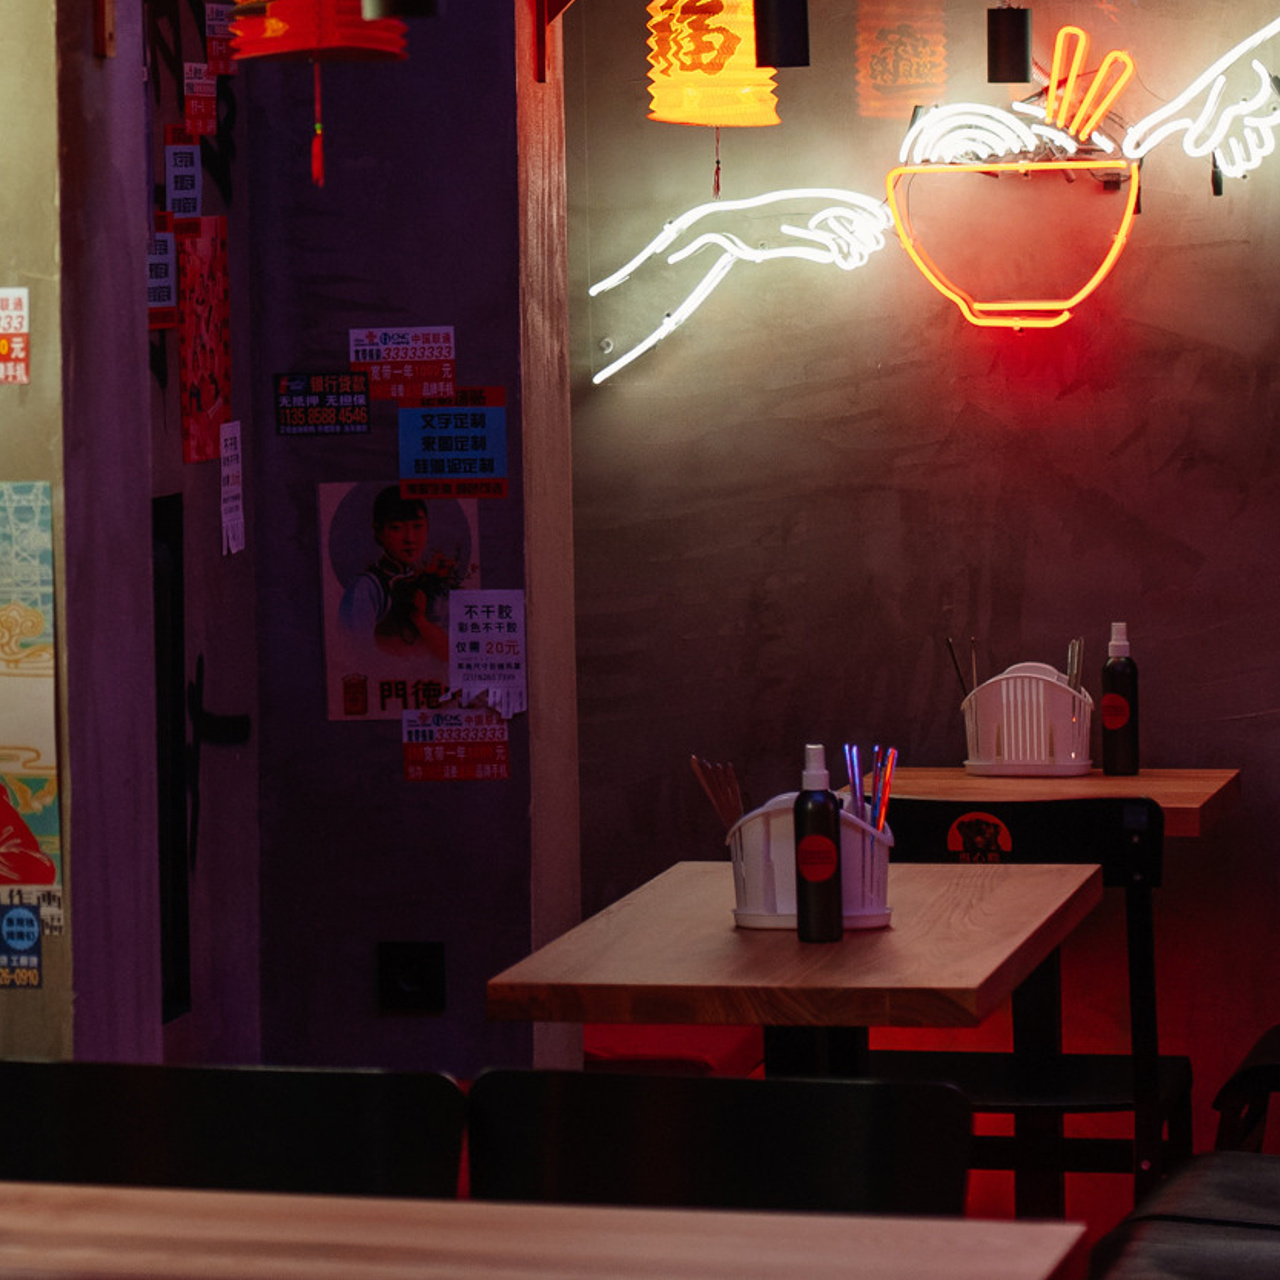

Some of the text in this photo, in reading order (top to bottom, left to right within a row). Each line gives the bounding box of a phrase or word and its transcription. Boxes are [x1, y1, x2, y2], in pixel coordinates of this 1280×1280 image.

[421, 412, 486, 430] 文字定制
[464, 604, 513, 620] 不干胶
[458, 622, 517, 634] 彩色不干胶
[485, 639, 521, 656] 20元
